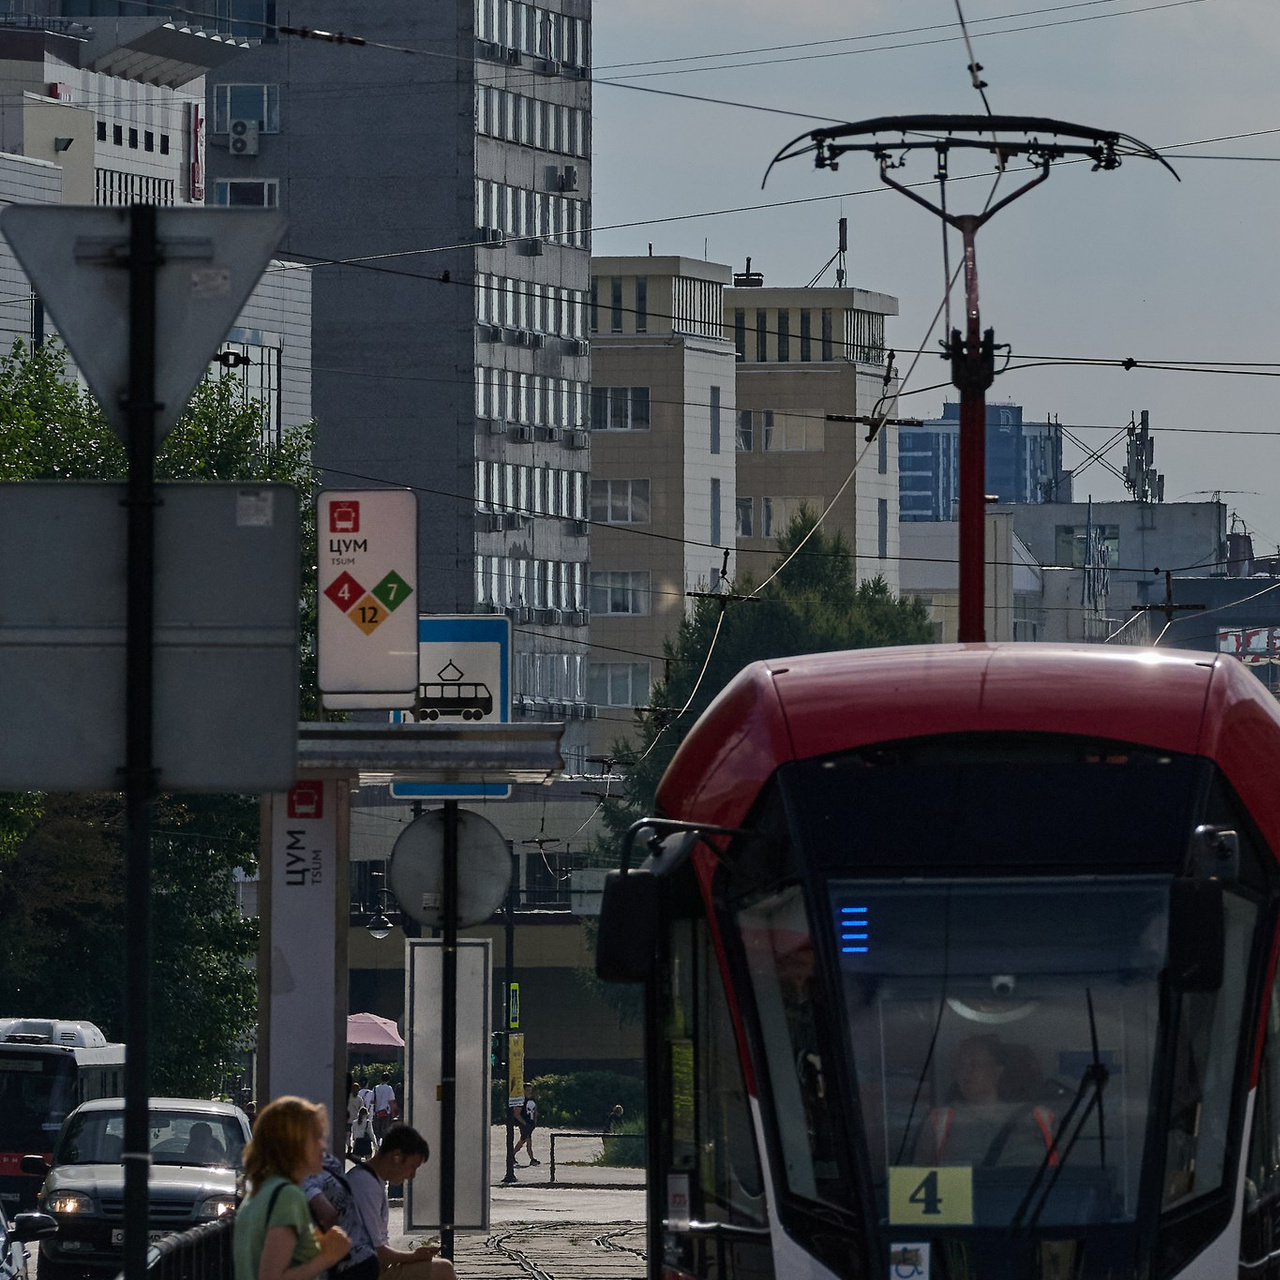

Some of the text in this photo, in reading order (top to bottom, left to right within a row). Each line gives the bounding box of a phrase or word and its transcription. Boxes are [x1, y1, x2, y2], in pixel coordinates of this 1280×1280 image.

[329, 539, 368, 555] ЦУМ
[337, 583, 398, 600] 4 7
[358, 607, 378, 623] 12
[286, 830, 310, 885] ЦУМ
[312, 850, 322, 885] TSUM
[908, 1170, 943, 1215] 4
